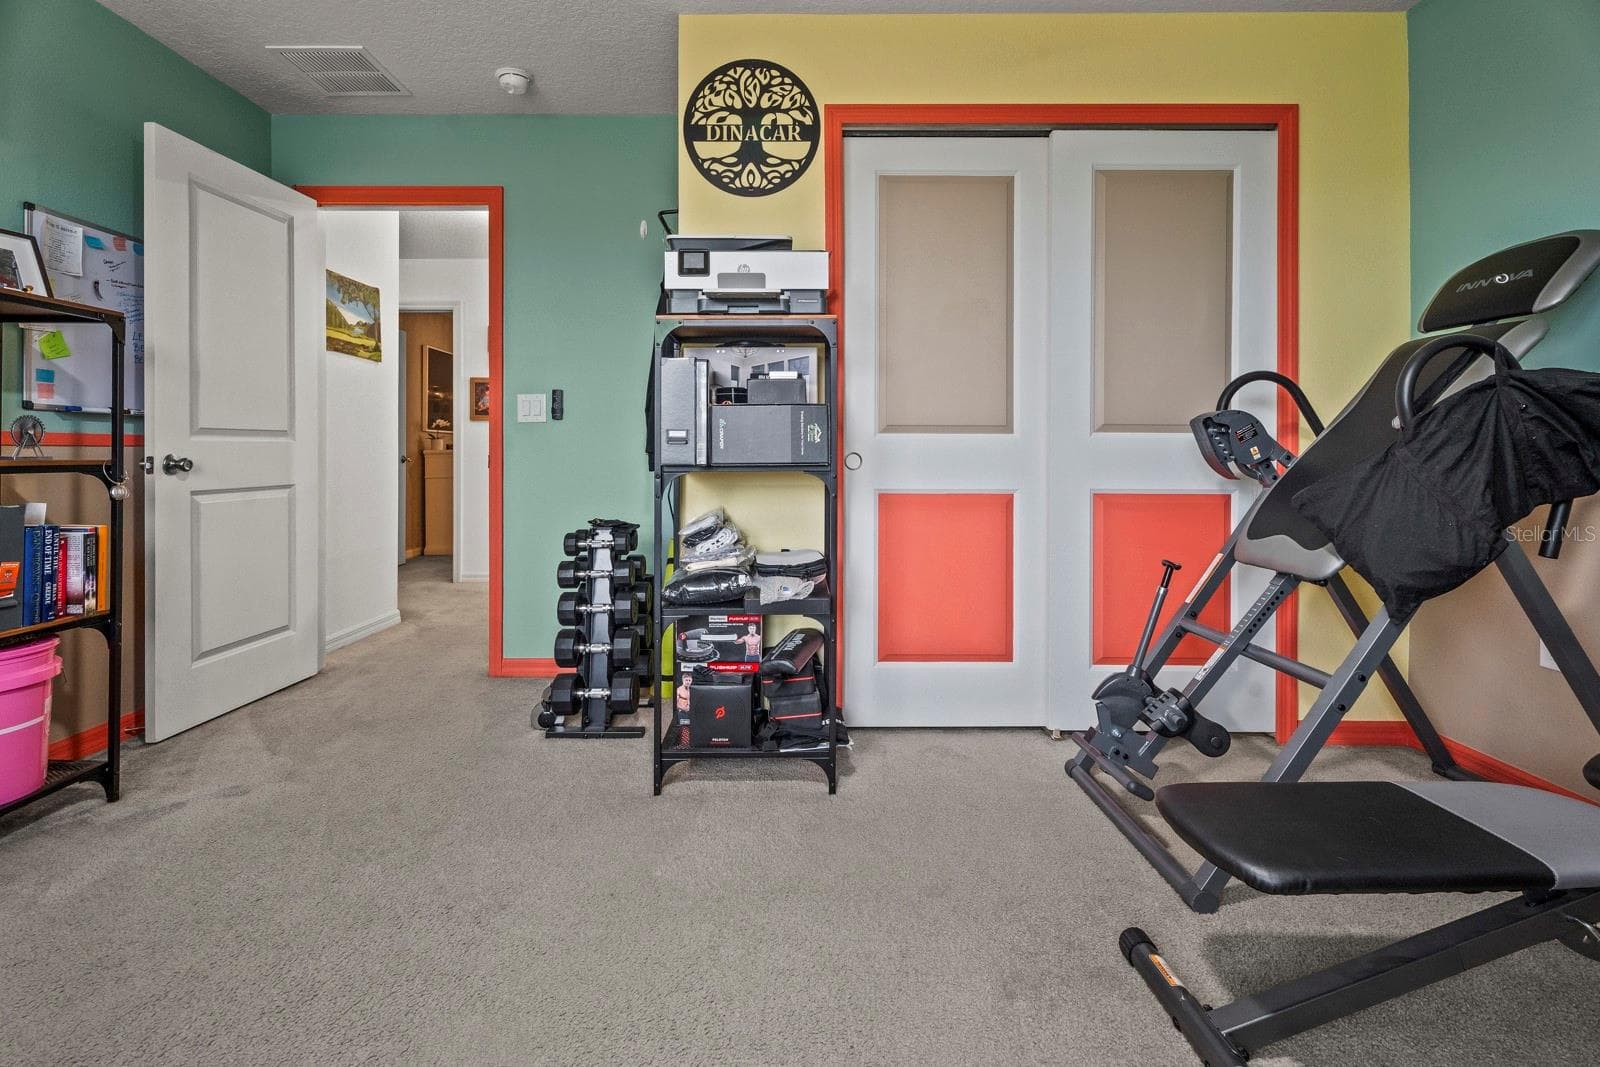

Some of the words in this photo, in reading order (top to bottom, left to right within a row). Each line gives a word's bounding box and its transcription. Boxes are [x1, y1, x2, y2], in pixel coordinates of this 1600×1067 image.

[706, 124, 801, 142] DINACAR
[1455, 268, 1534, 293] INNOVA
[44, 529, 52, 545] END
[44, 545, 52, 555] OF
[44, 555, 52, 575] TIME
